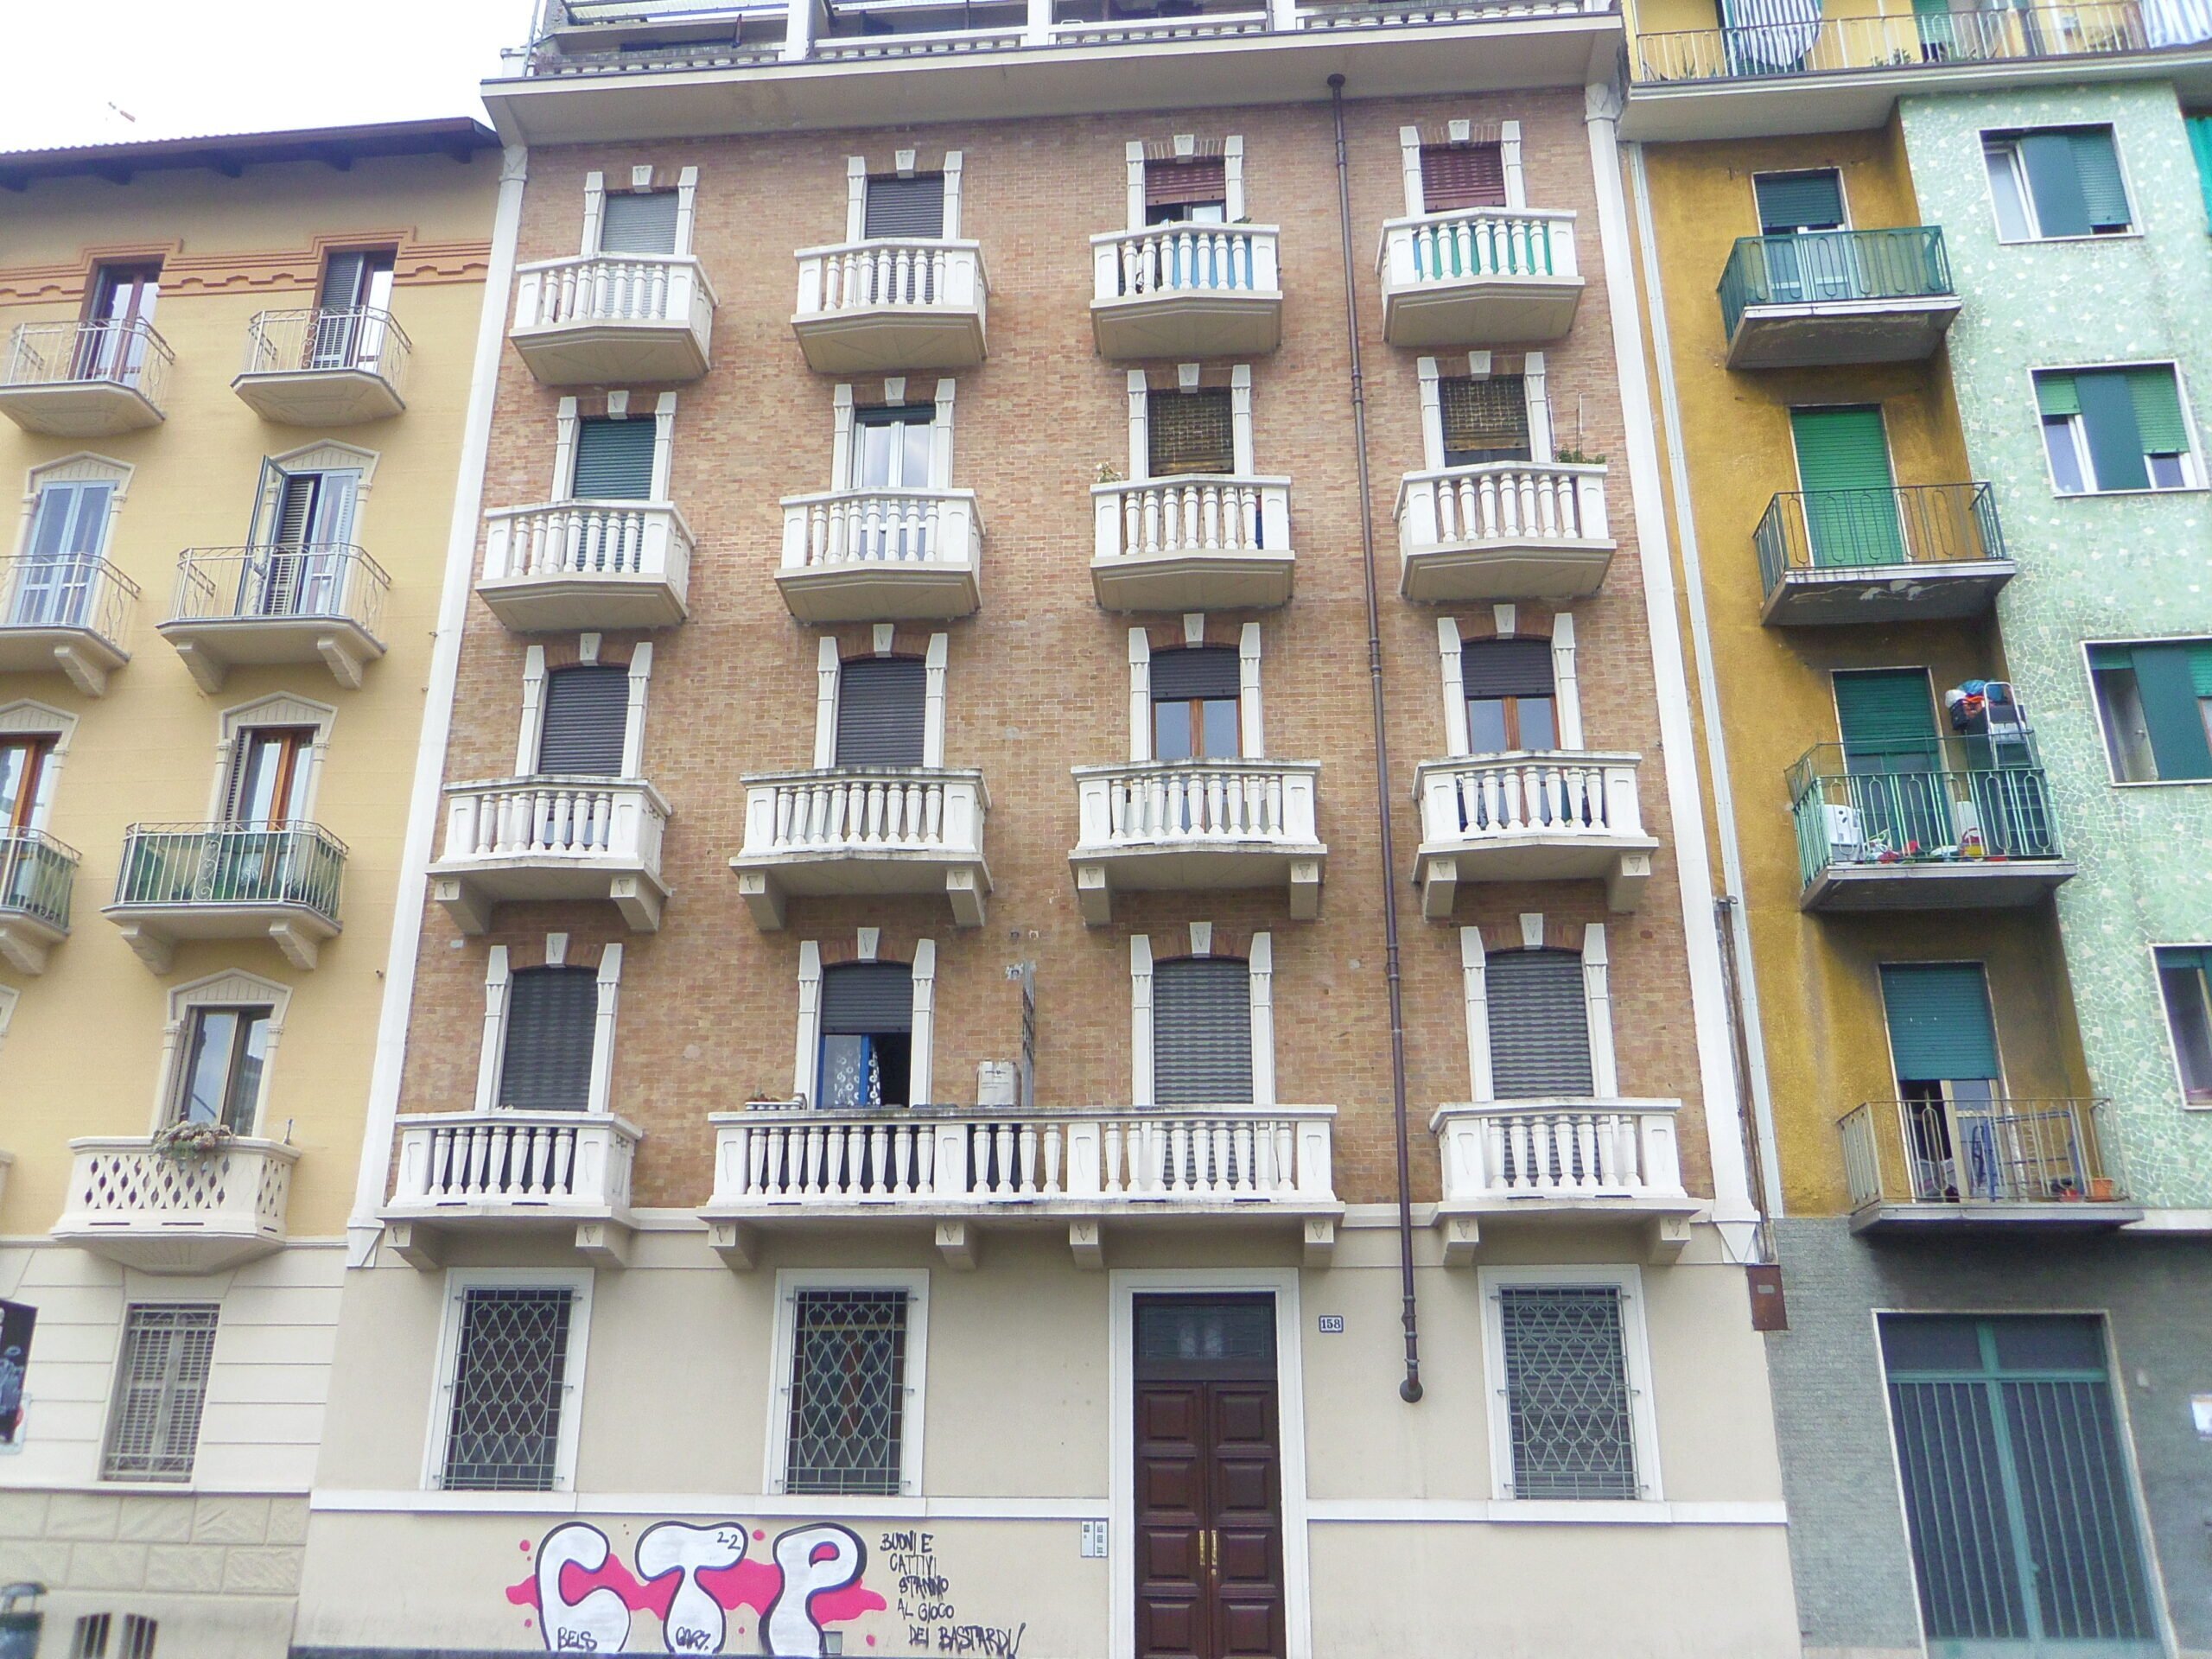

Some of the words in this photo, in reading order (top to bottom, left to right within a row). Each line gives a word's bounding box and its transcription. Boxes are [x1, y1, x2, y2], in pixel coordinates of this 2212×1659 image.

[1322, 1319, 1341, 1329] 158
[716, 1531, 741, 1551] 22
[880, 1530, 918, 1555] BUONI
[921, 1533, 933, 1554] E
[899, 1575, 950, 1599] STANNO
[897, 1598, 914, 1620] AL
[918, 1601, 955, 1624] GIOCO
[909, 1624, 930, 1649] DEI
